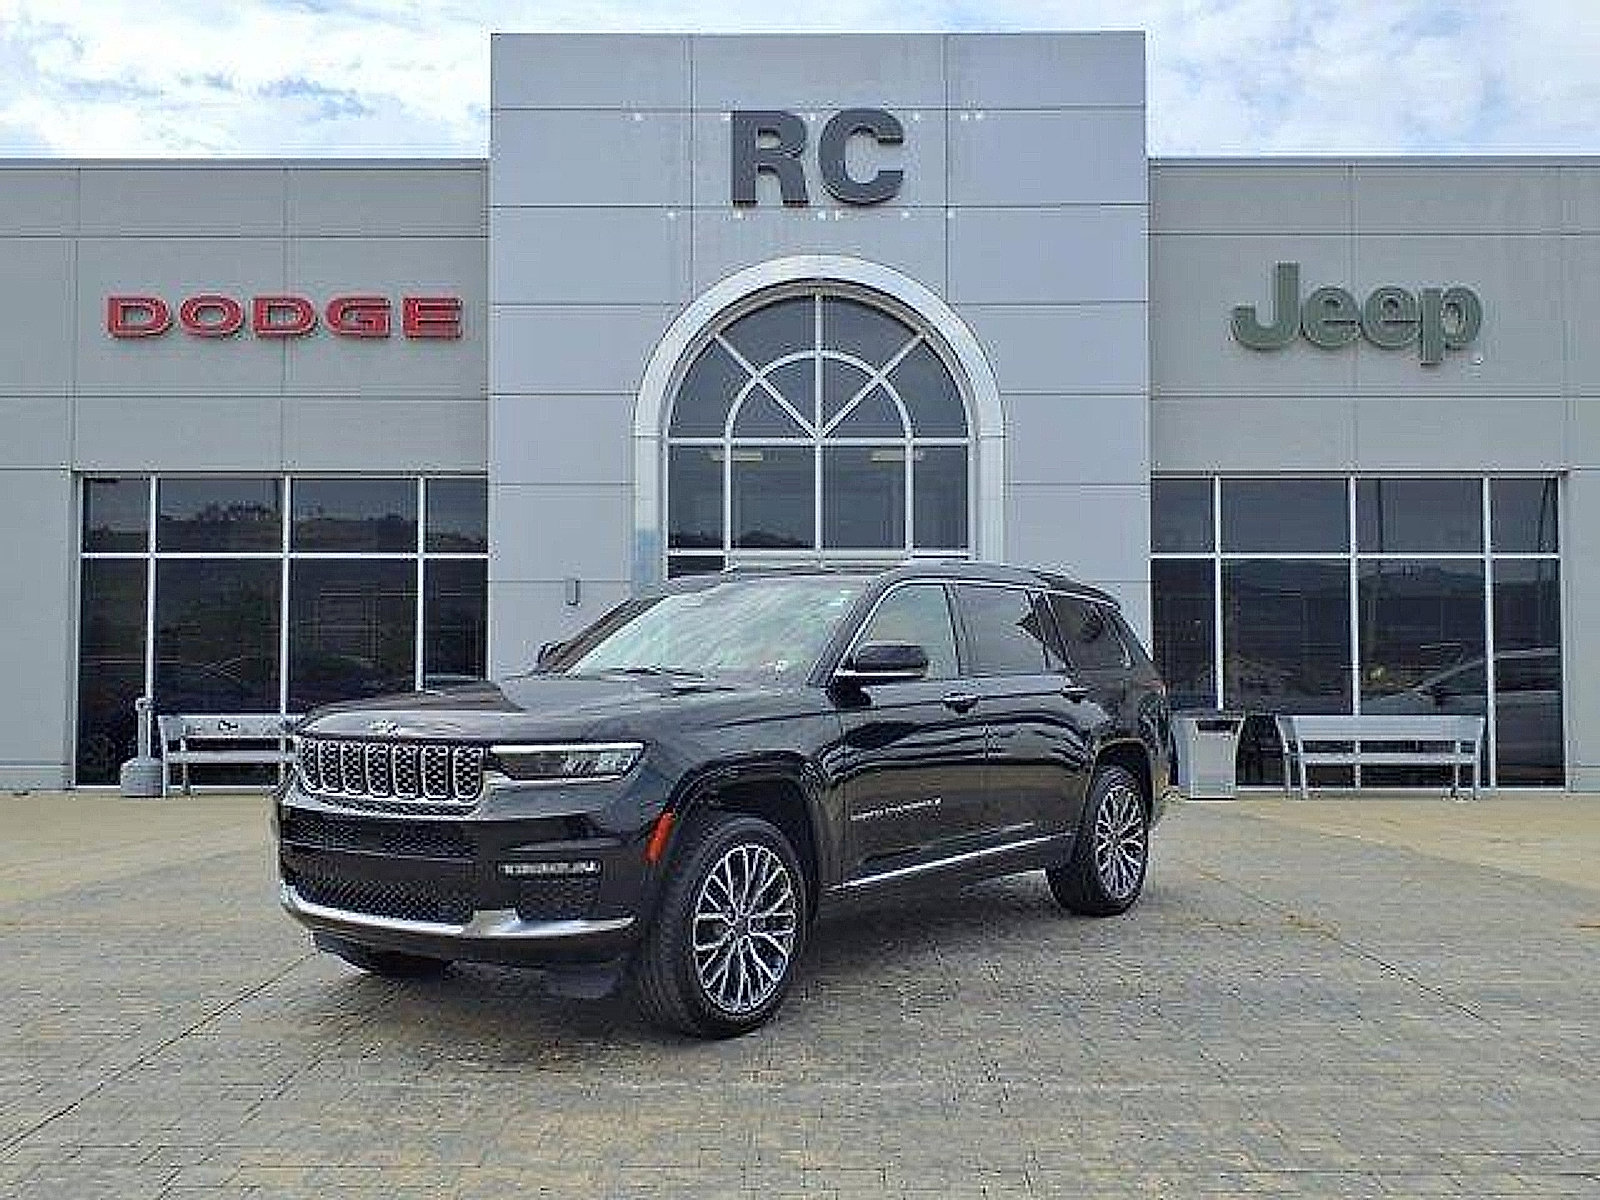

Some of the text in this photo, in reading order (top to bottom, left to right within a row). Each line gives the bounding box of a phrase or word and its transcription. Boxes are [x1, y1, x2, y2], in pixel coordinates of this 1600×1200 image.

[732, 108, 904, 207] RC
[107, 296, 463, 339] DODGE
[1231, 261, 1481, 365] Jeep
